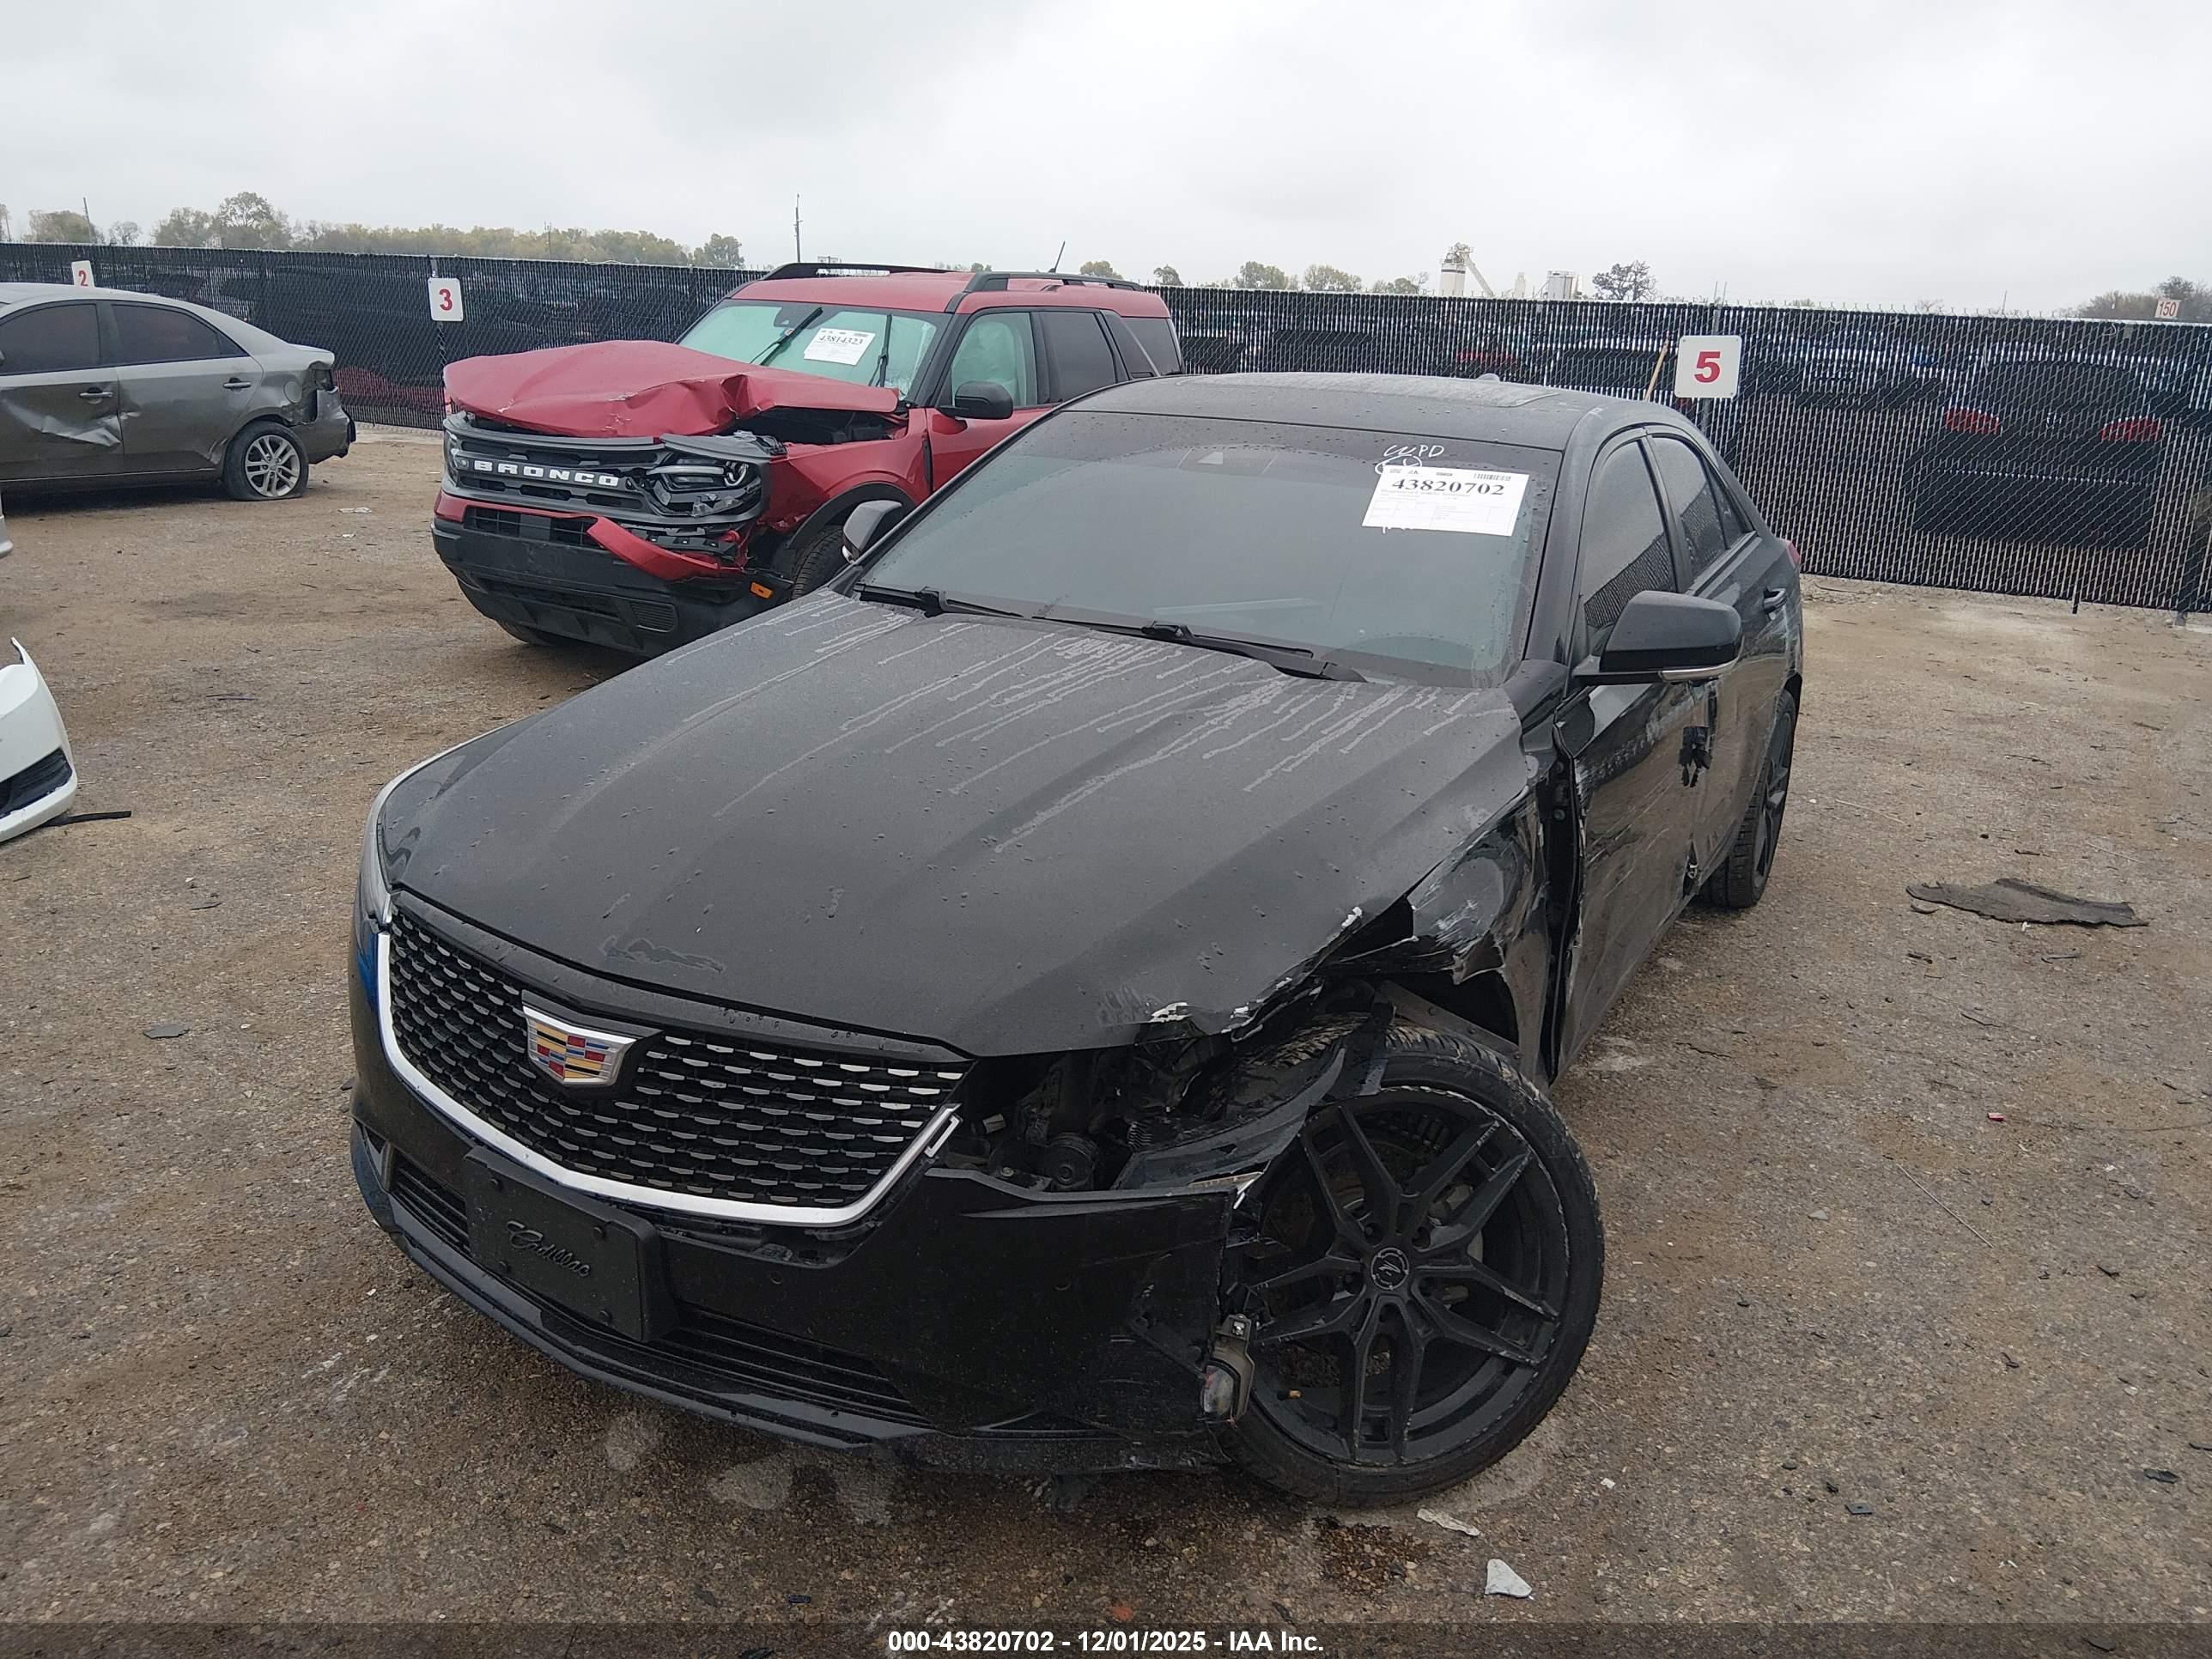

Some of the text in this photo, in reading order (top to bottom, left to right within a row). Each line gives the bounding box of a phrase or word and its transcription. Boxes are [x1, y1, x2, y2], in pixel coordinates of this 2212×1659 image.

[78, 270, 88, 287] 2
[439, 289, 453, 311] 3
[2159, 301, 2177, 317] 150
[1694, 351, 1721, 383] 5
[473, 459, 619, 488] BRONCO
[1391, 477, 1505, 495] 43820702
[506, 1220, 591, 1278] Cadillac
